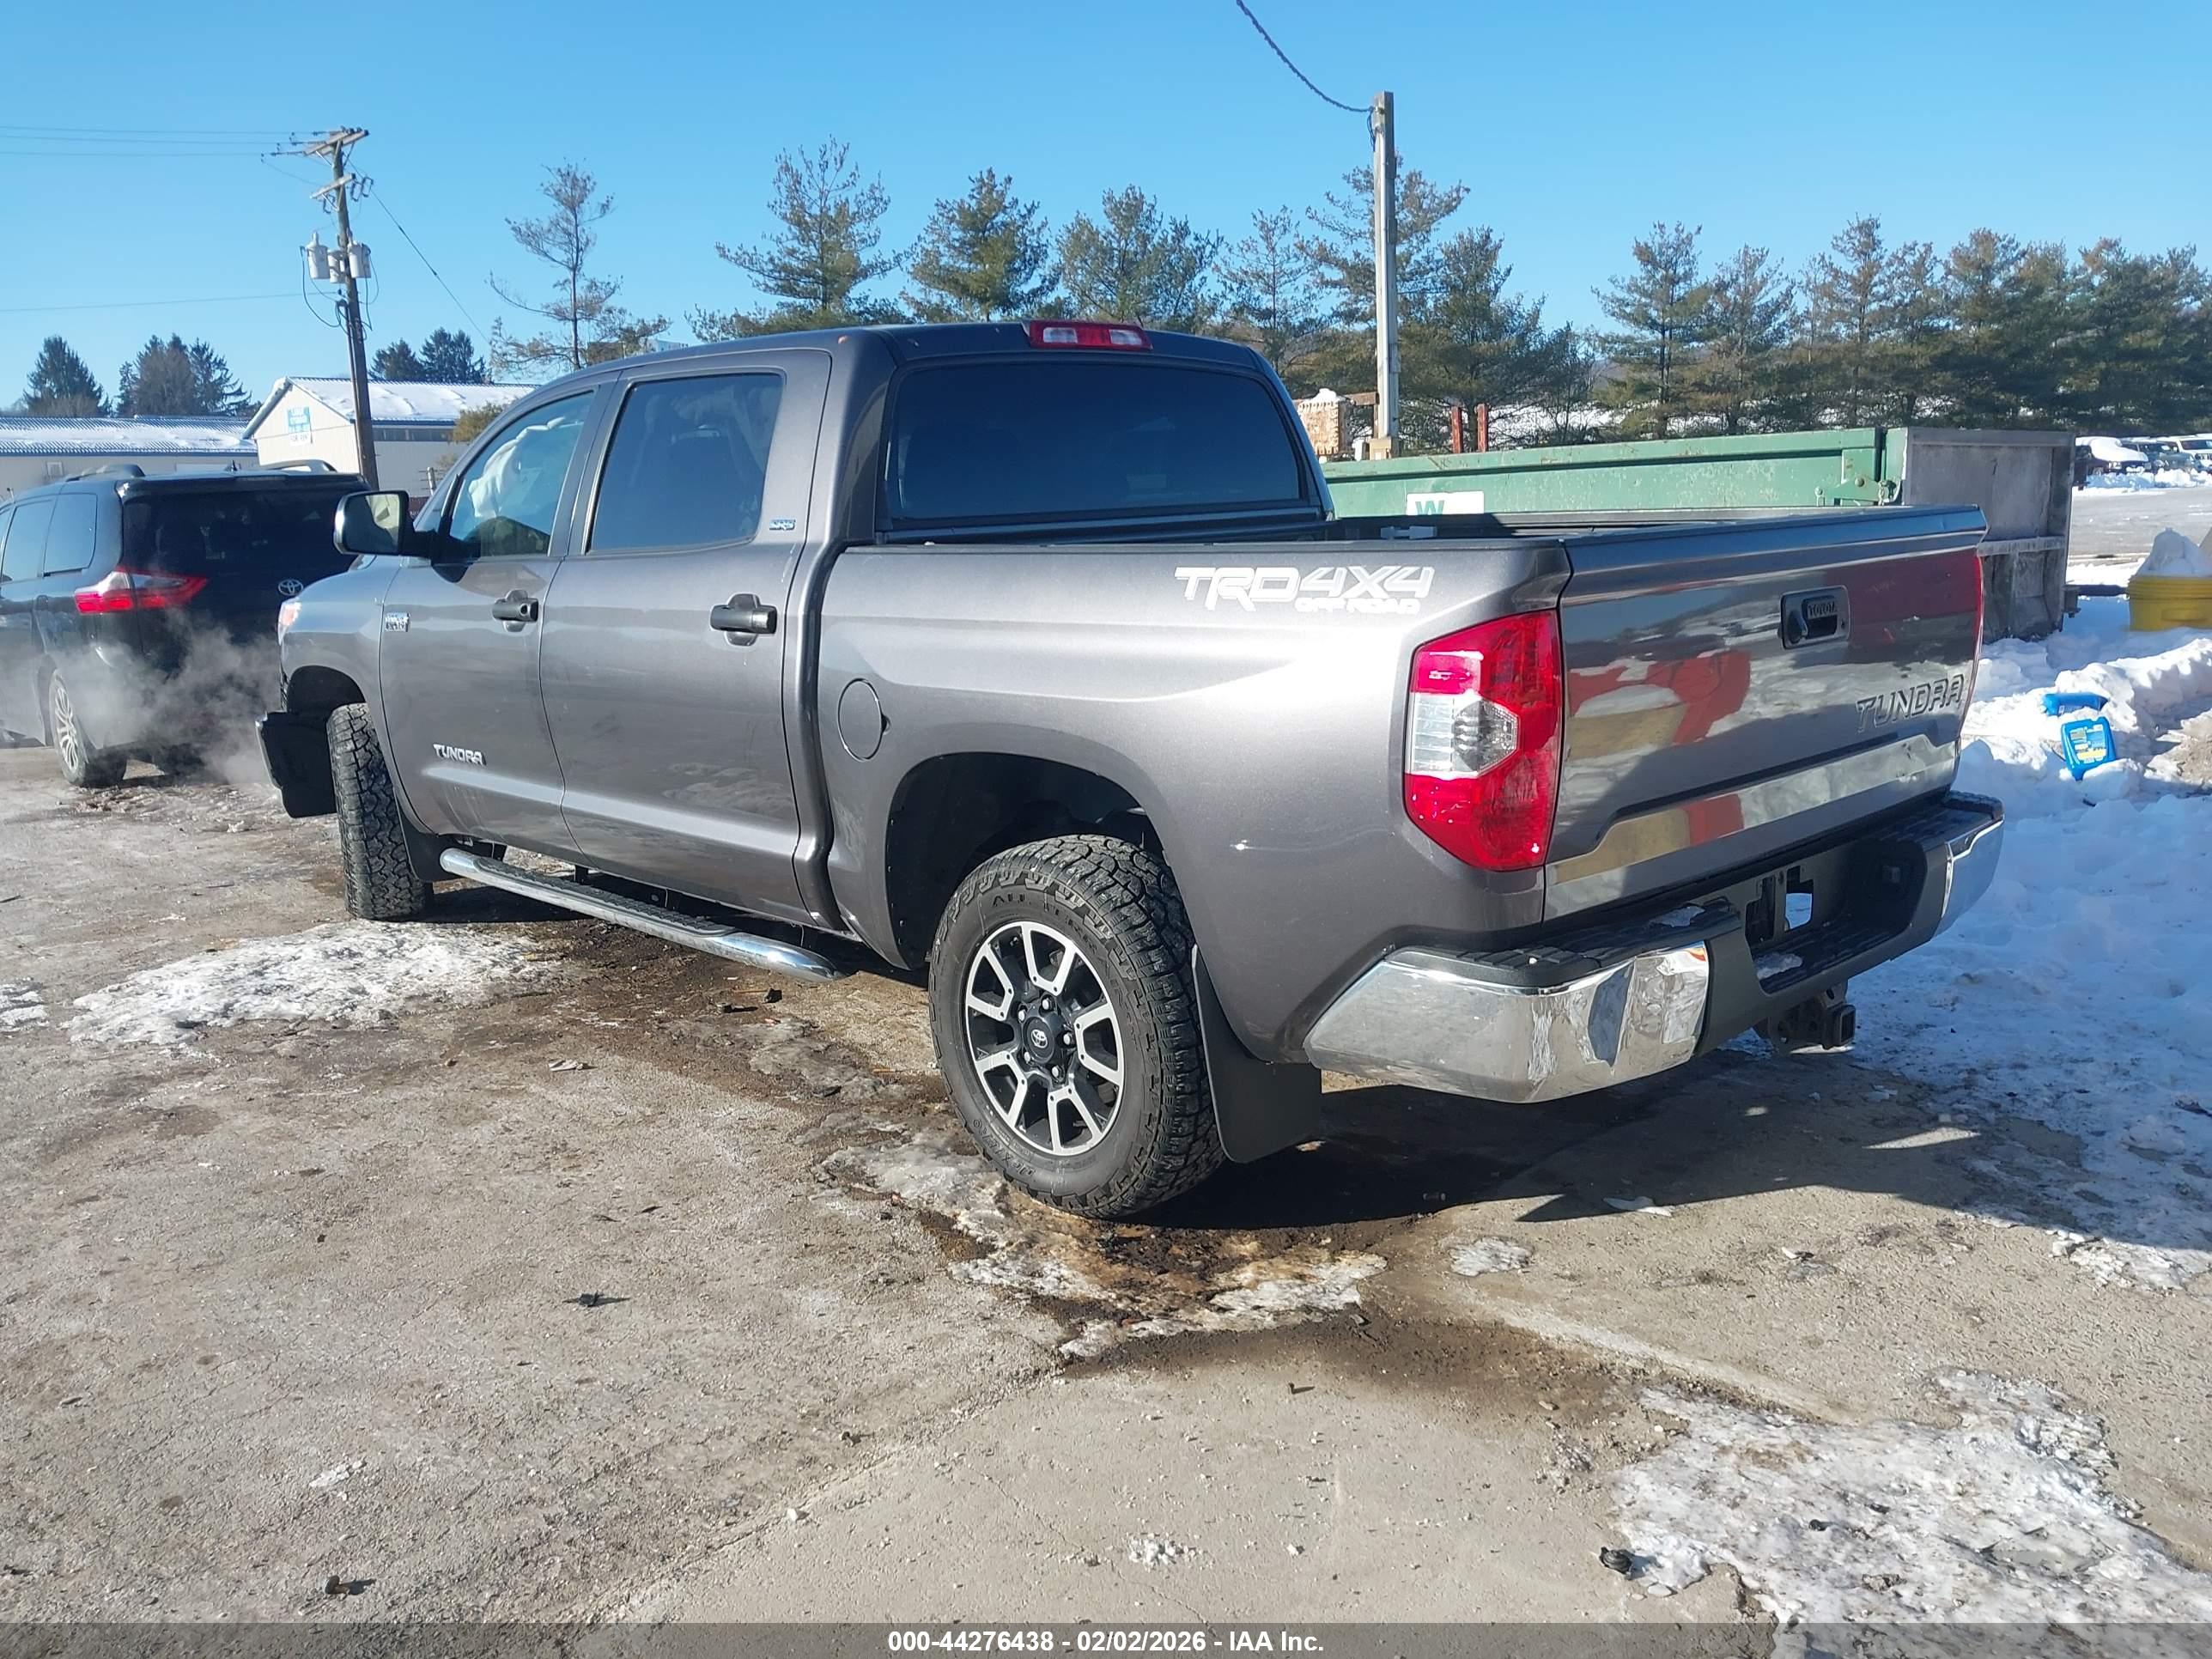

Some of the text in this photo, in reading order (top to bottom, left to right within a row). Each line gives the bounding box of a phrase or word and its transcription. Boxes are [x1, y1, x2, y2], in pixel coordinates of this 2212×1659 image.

[1175, 565, 1435, 612] TRD 4X4
[1294, 598, 1422, 615] OFF ROAD
[1855, 673, 1965, 732] TUNDRA
[432, 743, 487, 766] TUNDRA
